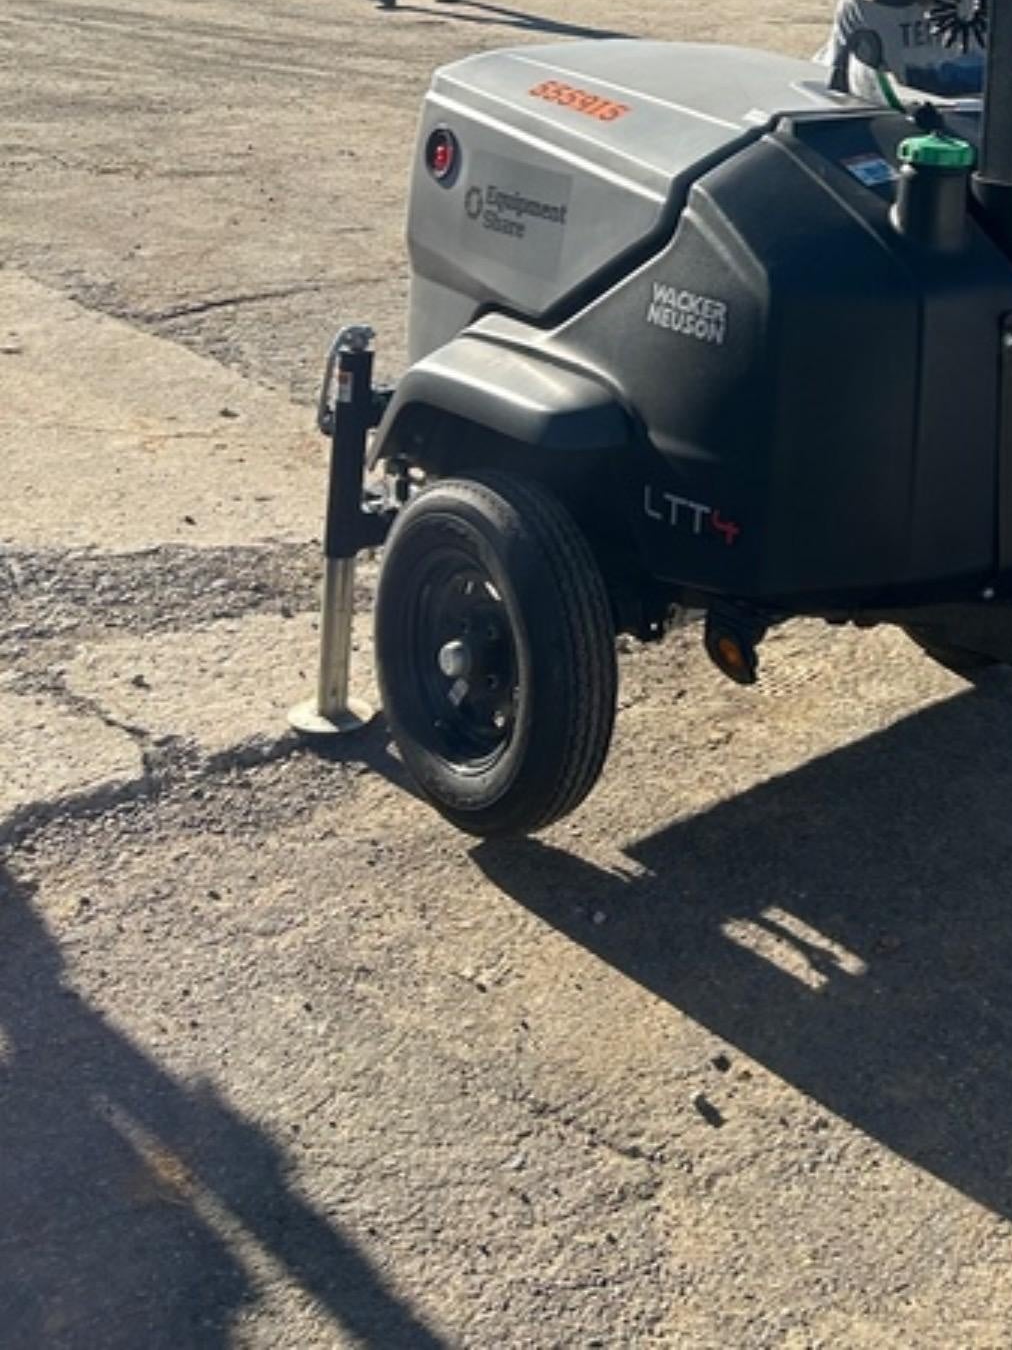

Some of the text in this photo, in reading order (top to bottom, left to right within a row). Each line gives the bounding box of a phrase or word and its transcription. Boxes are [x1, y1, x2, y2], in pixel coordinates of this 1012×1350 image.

[482, 209, 526, 238] Share
[486, 184, 567, 224] Equipment
[652, 282, 727, 320] WACKER
[646, 302, 727, 346] NEUSON
[644, 485, 738, 544] LTT4
